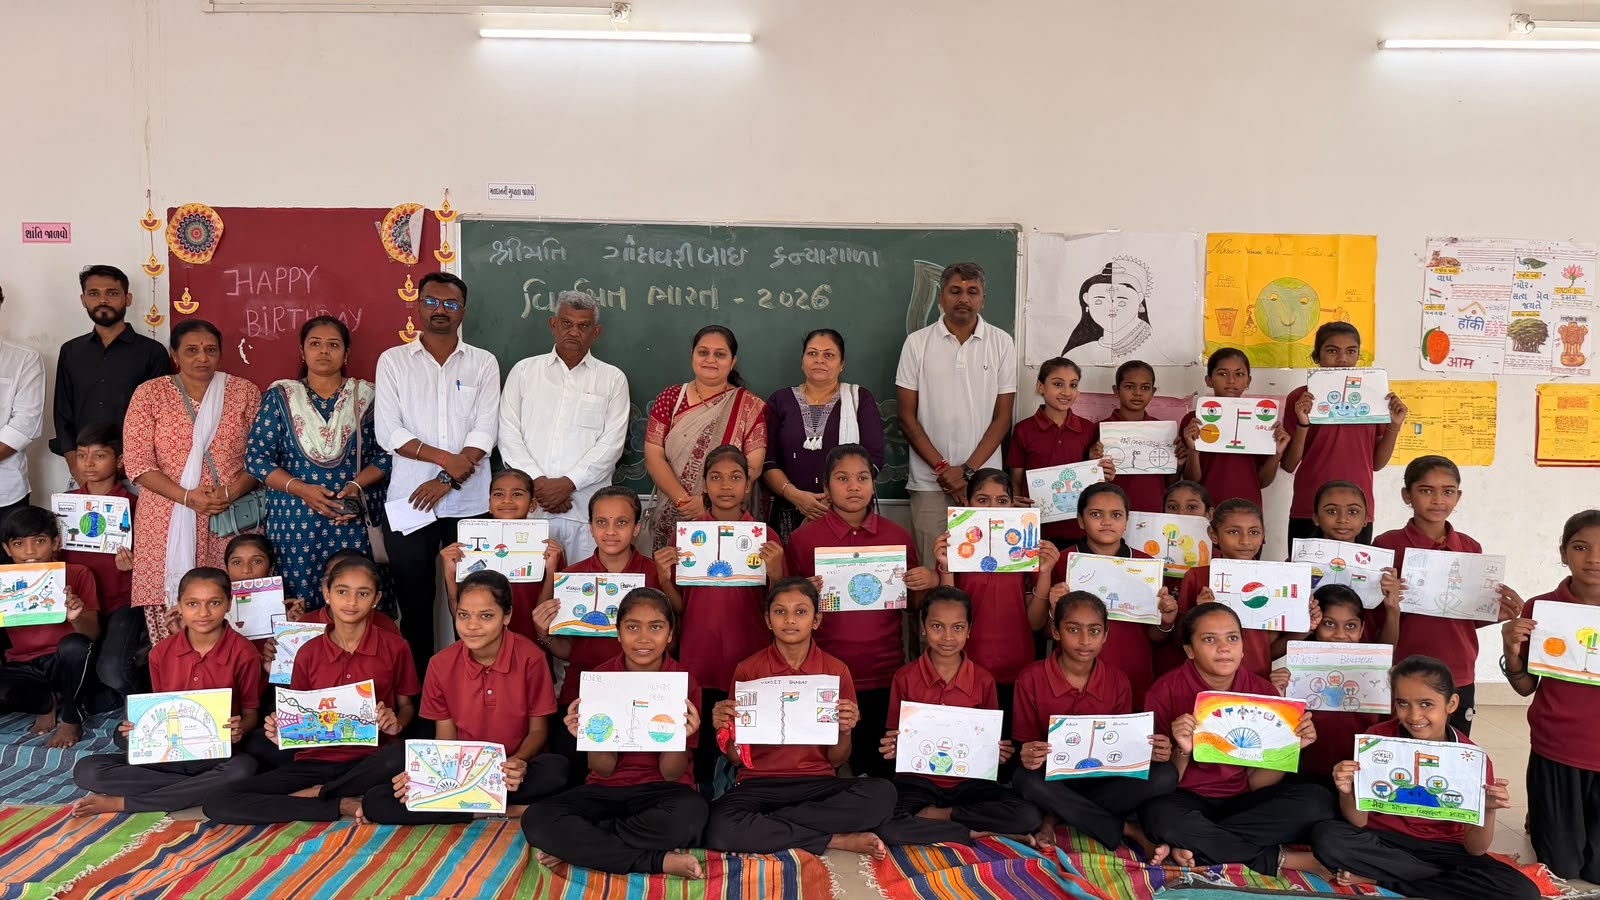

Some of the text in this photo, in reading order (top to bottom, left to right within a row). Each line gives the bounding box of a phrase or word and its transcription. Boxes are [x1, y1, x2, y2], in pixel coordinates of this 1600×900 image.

[25, 226, 68, 239] શાંતિ જાળવો
[224, 265, 319, 297] HAPPY
[647, 283, 719, 310] ભારત
[1458, 314, 1485, 331] हॉकी
[1447, 356, 1475, 369] आम
[318, 696, 338, 710] AI
